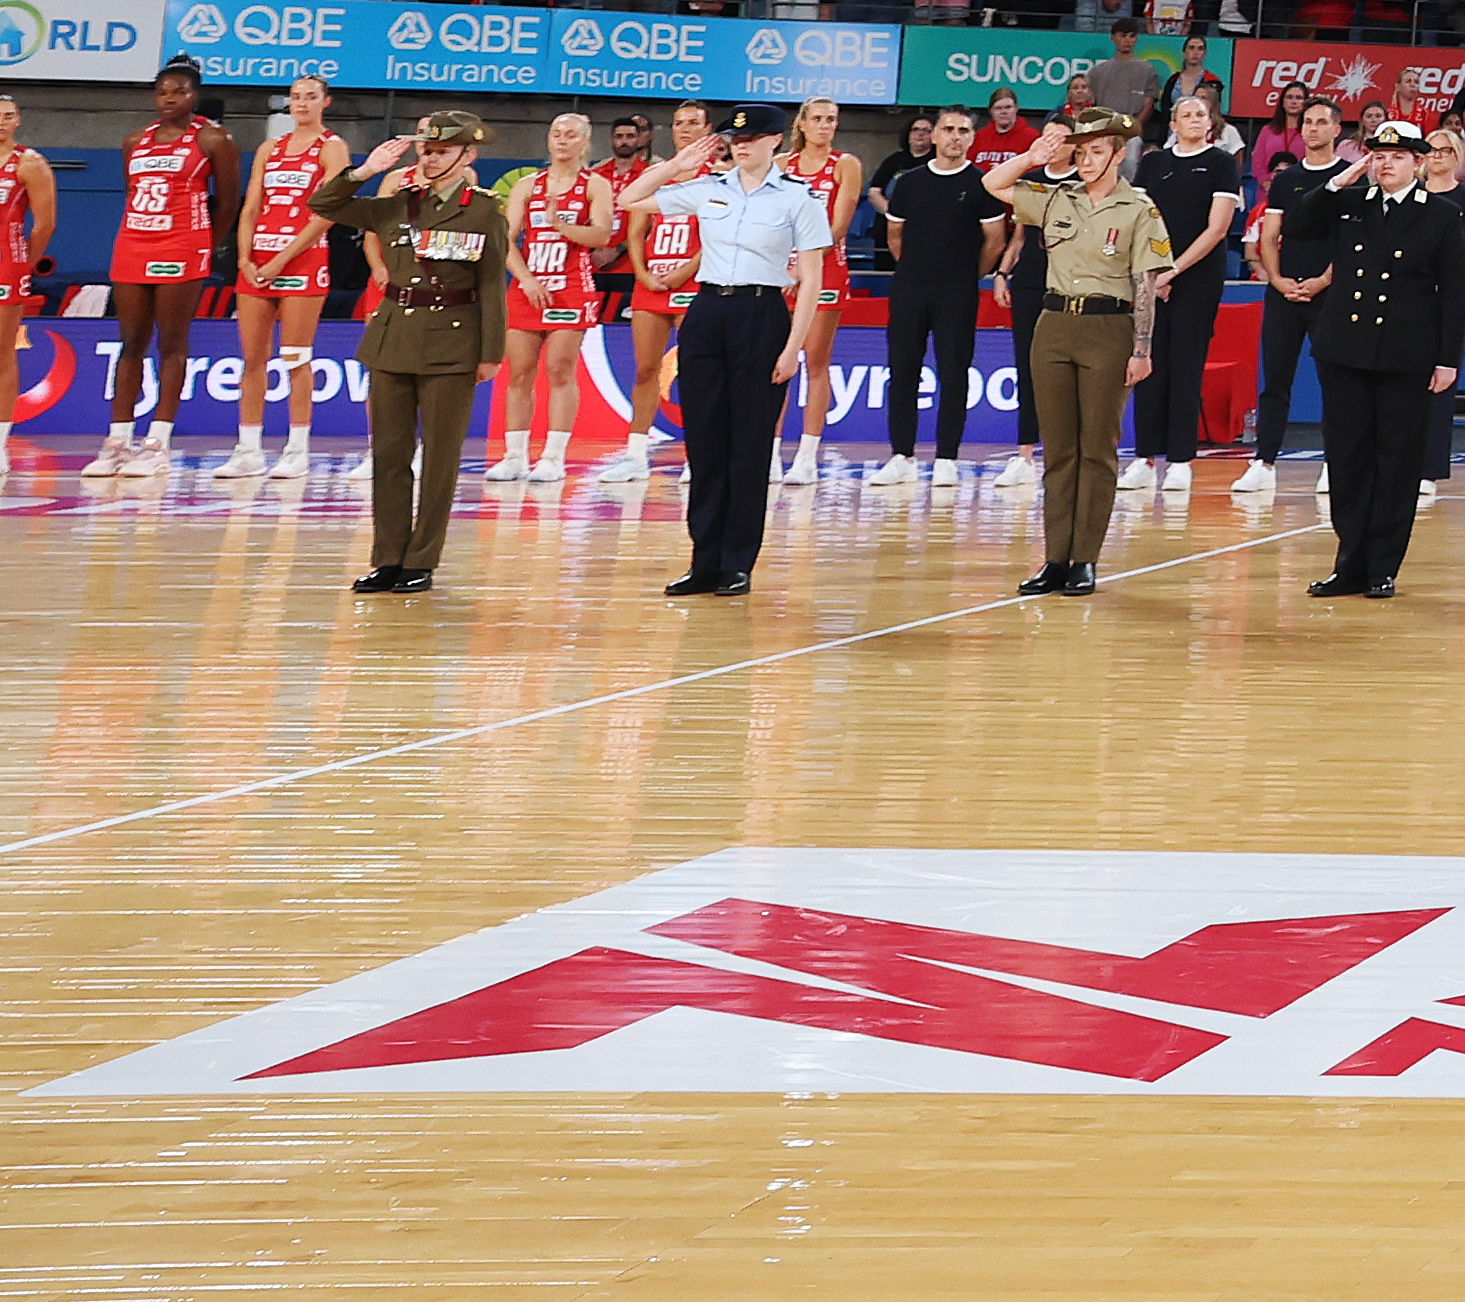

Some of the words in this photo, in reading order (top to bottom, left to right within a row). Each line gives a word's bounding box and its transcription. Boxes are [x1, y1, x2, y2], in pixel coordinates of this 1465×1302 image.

[48, 19, 138, 53] RLD
[233, 4, 347, 48] QBE
[438, 12, 542, 55] QBE
[609, 20, 707, 63] QBE
[793, 29, 892, 69] QBE
[385, 54, 537, 85] Insurance
[559, 60, 704, 92] Insurance
[744, 69, 887, 97] Insurance
[944, 52, 1108, 86] SUNCOR
[1251, 55, 1330, 89] red
[143, 157, 183, 170] QBE
[274, 173, 310, 187] QBE
[653, 224, 691, 256] GA
[527, 242, 569, 274] WA
